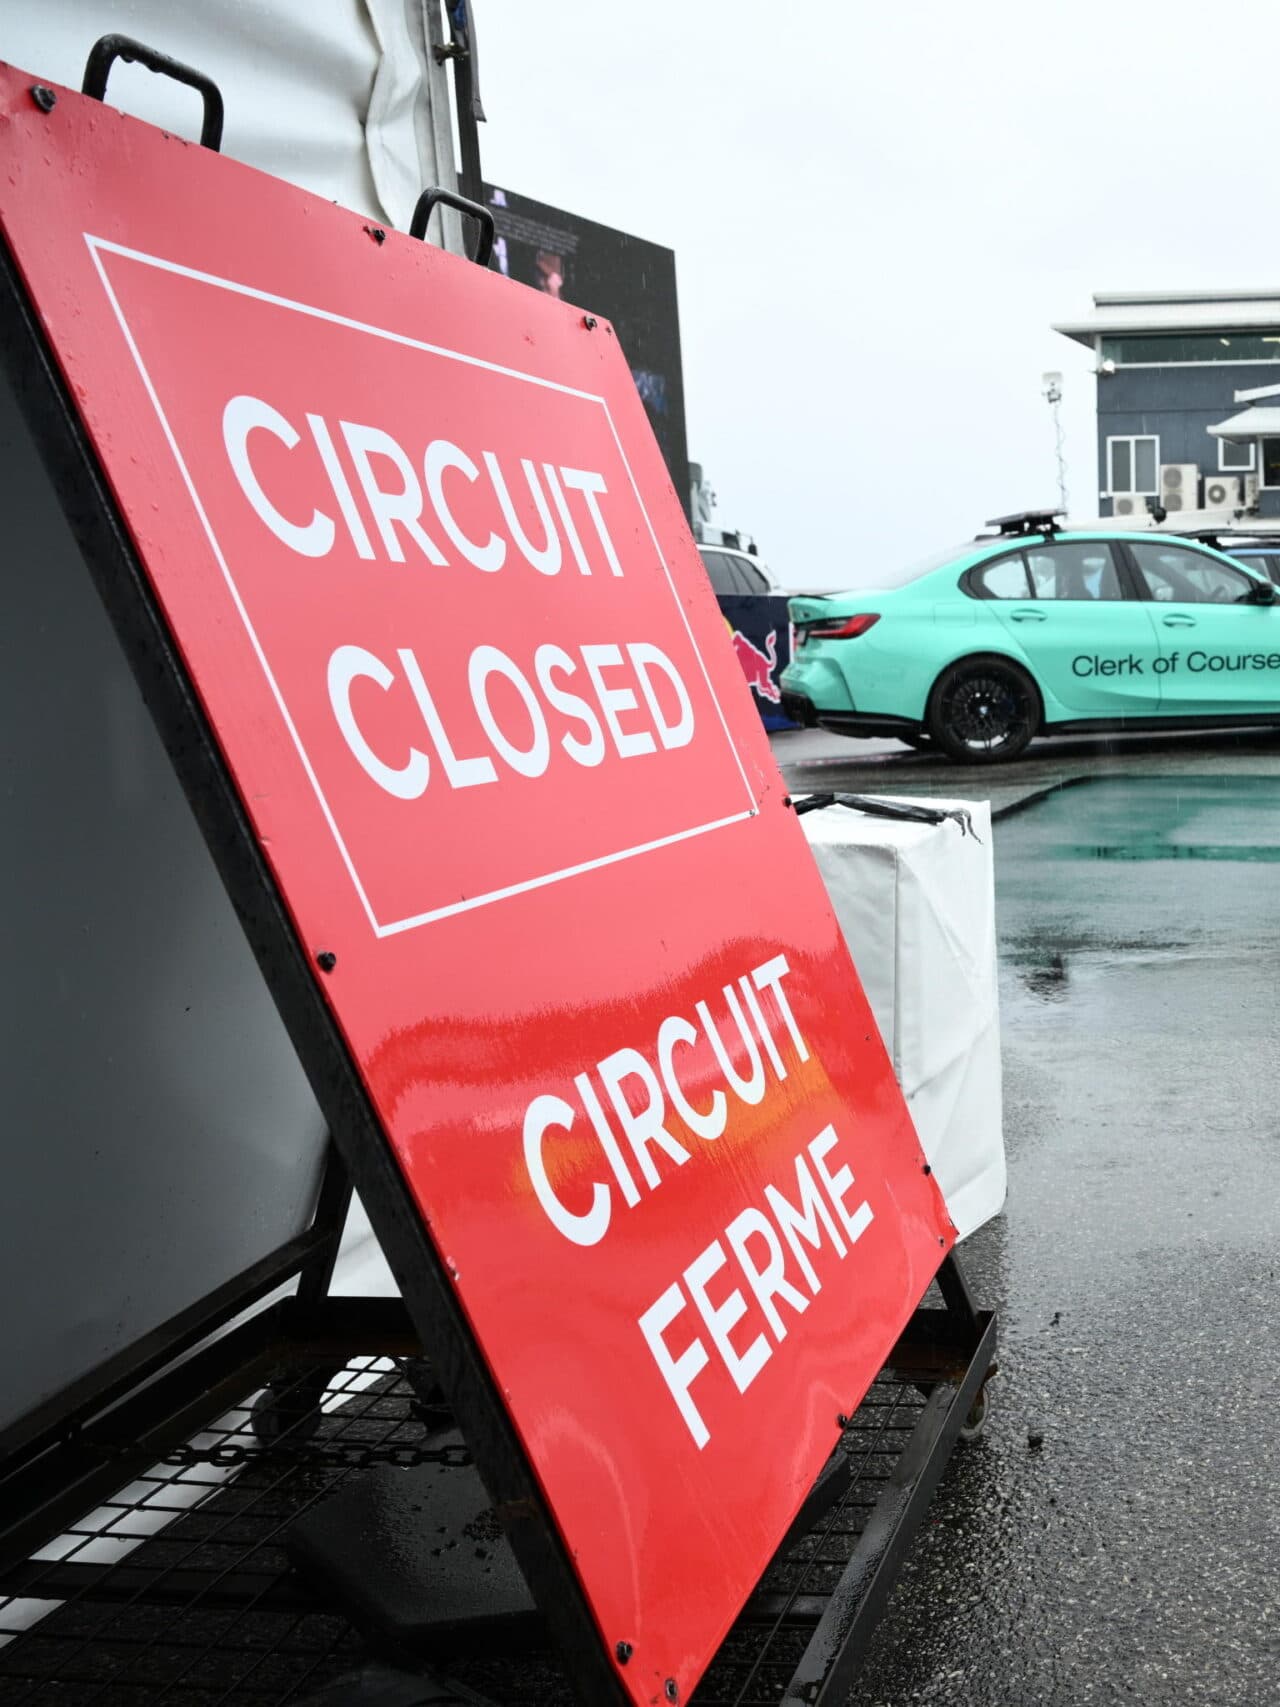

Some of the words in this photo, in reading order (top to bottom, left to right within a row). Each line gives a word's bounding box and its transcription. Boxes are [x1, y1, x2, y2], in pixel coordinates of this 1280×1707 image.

[222, 395, 625, 577] CIRCUIT
[327, 642, 695, 800] CLOSED
[1072, 654, 1144, 677] Clerk
[1152, 652, 1179, 674] of
[523, 953, 810, 1246] CIRCUIT
[638, 1123, 874, 1450] FERME
